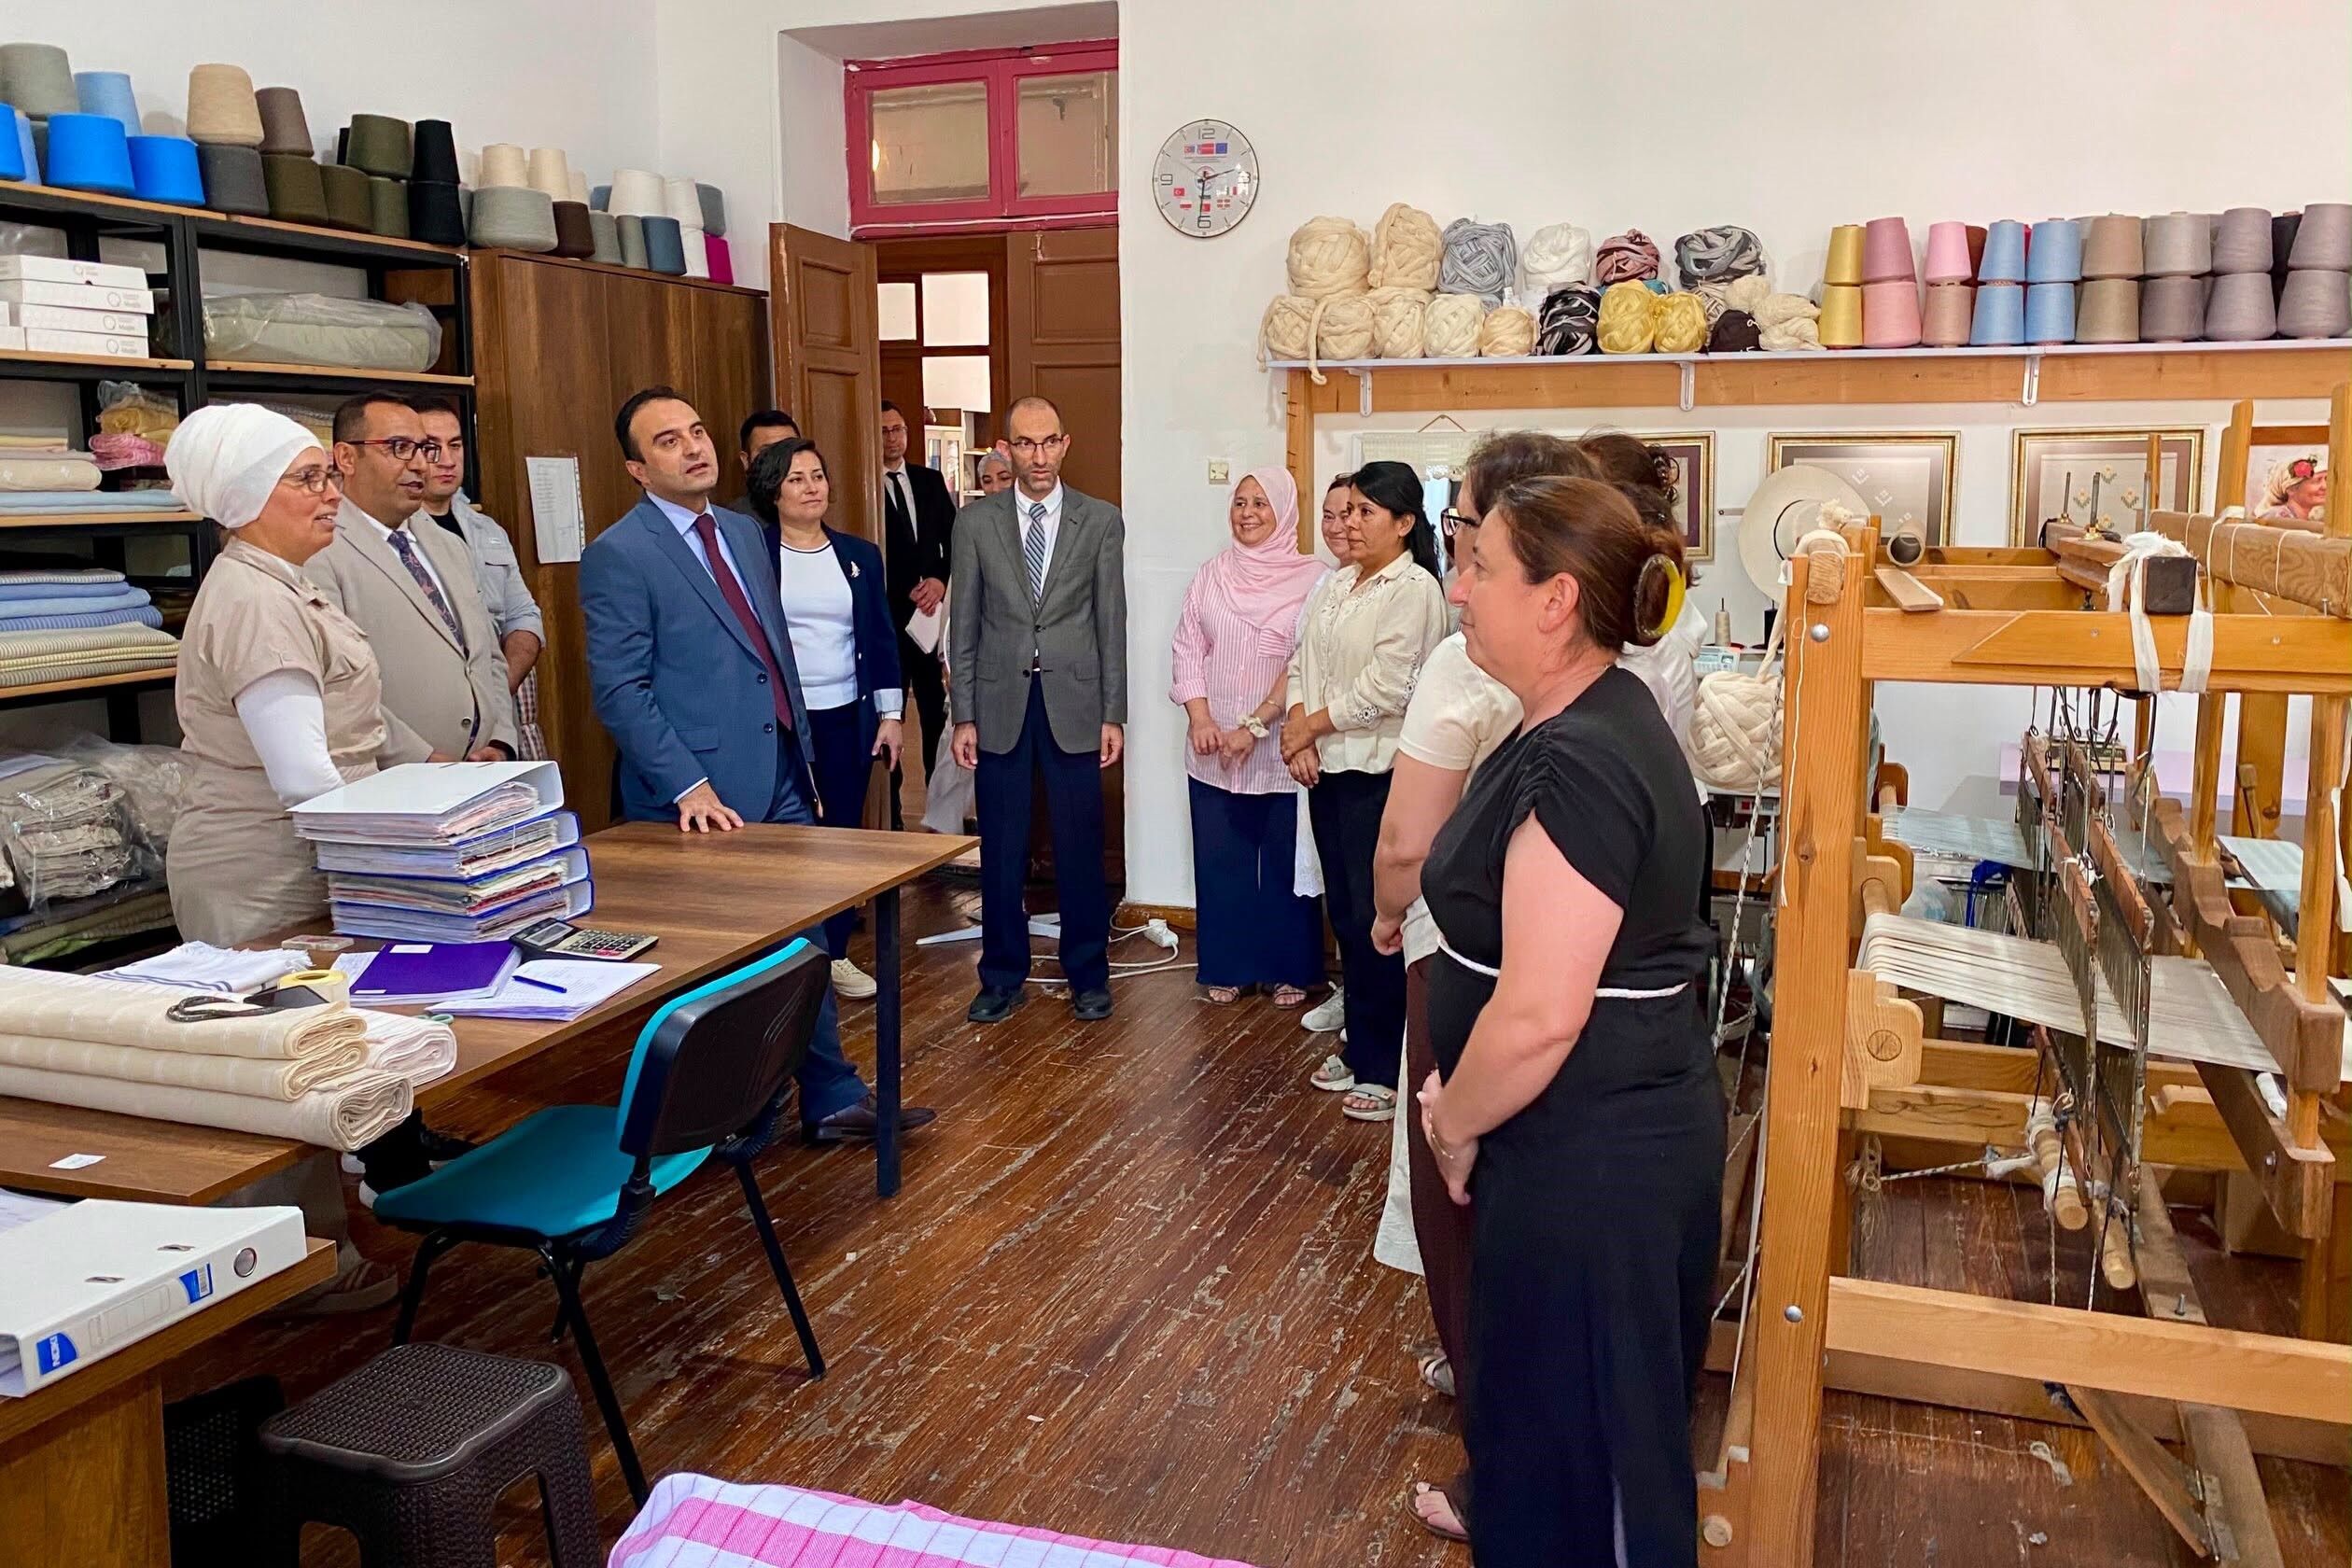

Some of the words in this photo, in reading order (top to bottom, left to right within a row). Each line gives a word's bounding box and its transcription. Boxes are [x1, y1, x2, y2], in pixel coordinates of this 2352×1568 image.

[1197, 128, 1215, 140] 12
[1160, 174, 1173, 186] 9
[1197, 215, 1211, 229] 6
